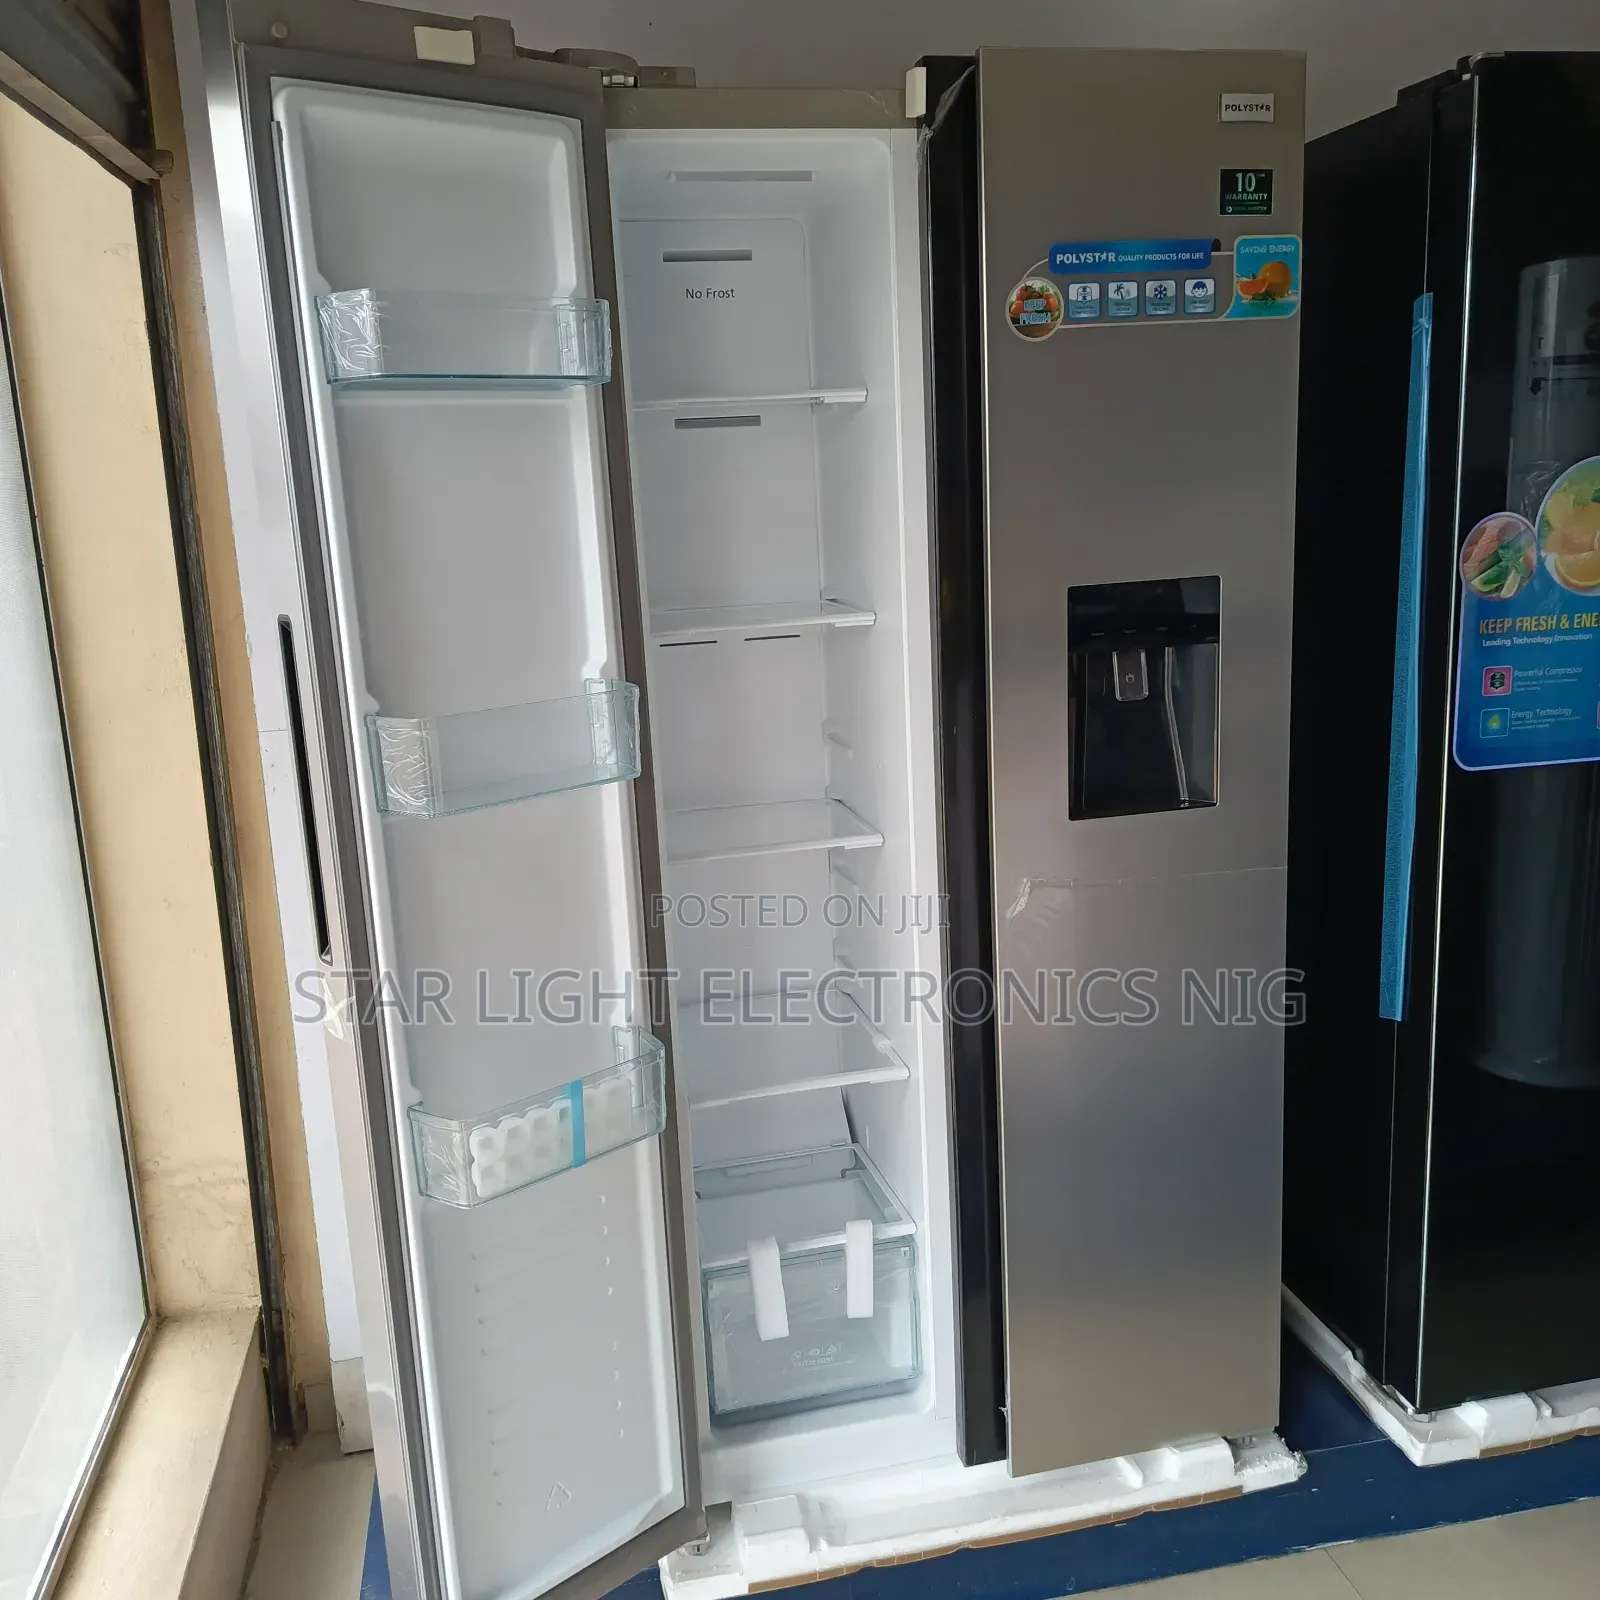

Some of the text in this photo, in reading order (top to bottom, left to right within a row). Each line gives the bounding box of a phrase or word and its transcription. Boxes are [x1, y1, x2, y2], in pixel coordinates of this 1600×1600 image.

[1235, 172, 1256, 192] 10
[1118, 254, 1144, 262] QUALITY
[1144, 253, 1177, 261] PRODUCTS
[1178, 252, 1191, 260] FOR
[685, 287, 736, 299] No Frost
[1479, 612, 1600, 634] KEEP FRESH & ENE
[1482, 638, 1511, 647] Leading
[1512, 634, 1553, 644] Technology
[1514, 666, 1583, 677] Powerful Compressor
[1511, 707, 1573, 719] Energy Technology
